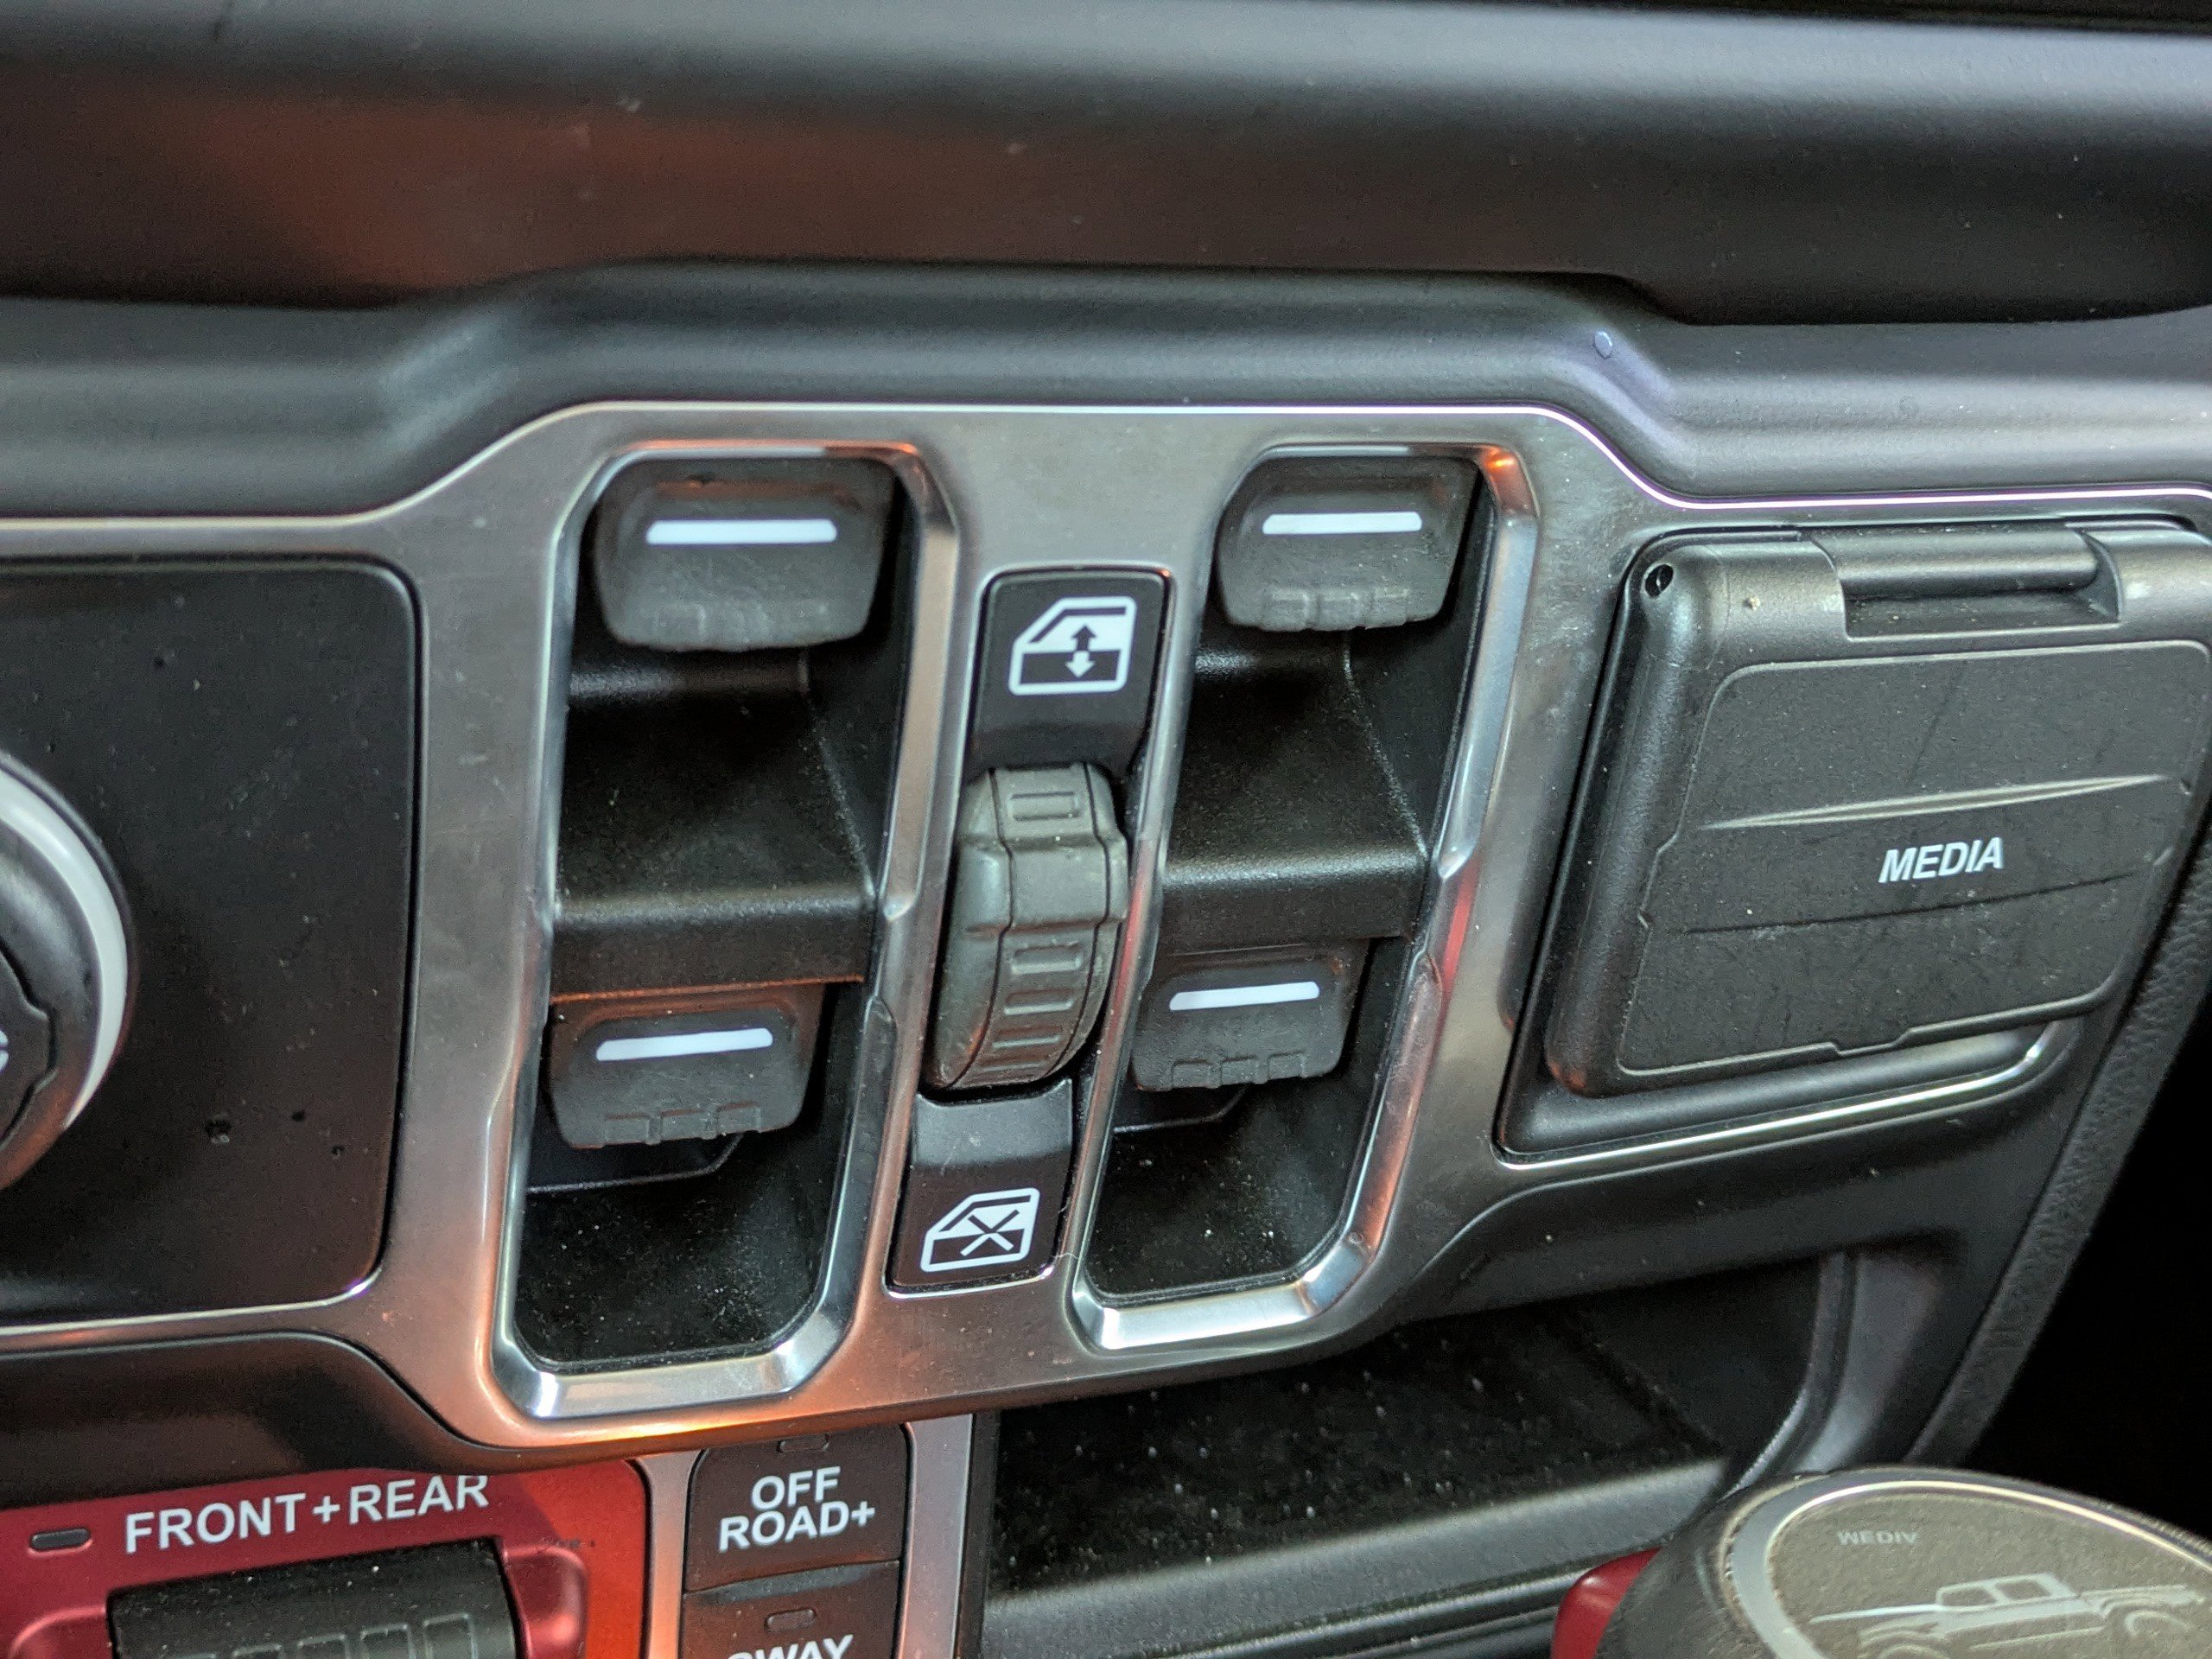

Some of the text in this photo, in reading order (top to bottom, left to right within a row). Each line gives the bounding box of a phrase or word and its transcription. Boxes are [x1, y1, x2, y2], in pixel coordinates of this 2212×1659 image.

[1878, 836, 2003, 883] MEDIA
[751, 1466, 841, 1511] OFF
[719, 1501, 875, 1552] ROAD+
[728, 1634, 854, 1659] AY
